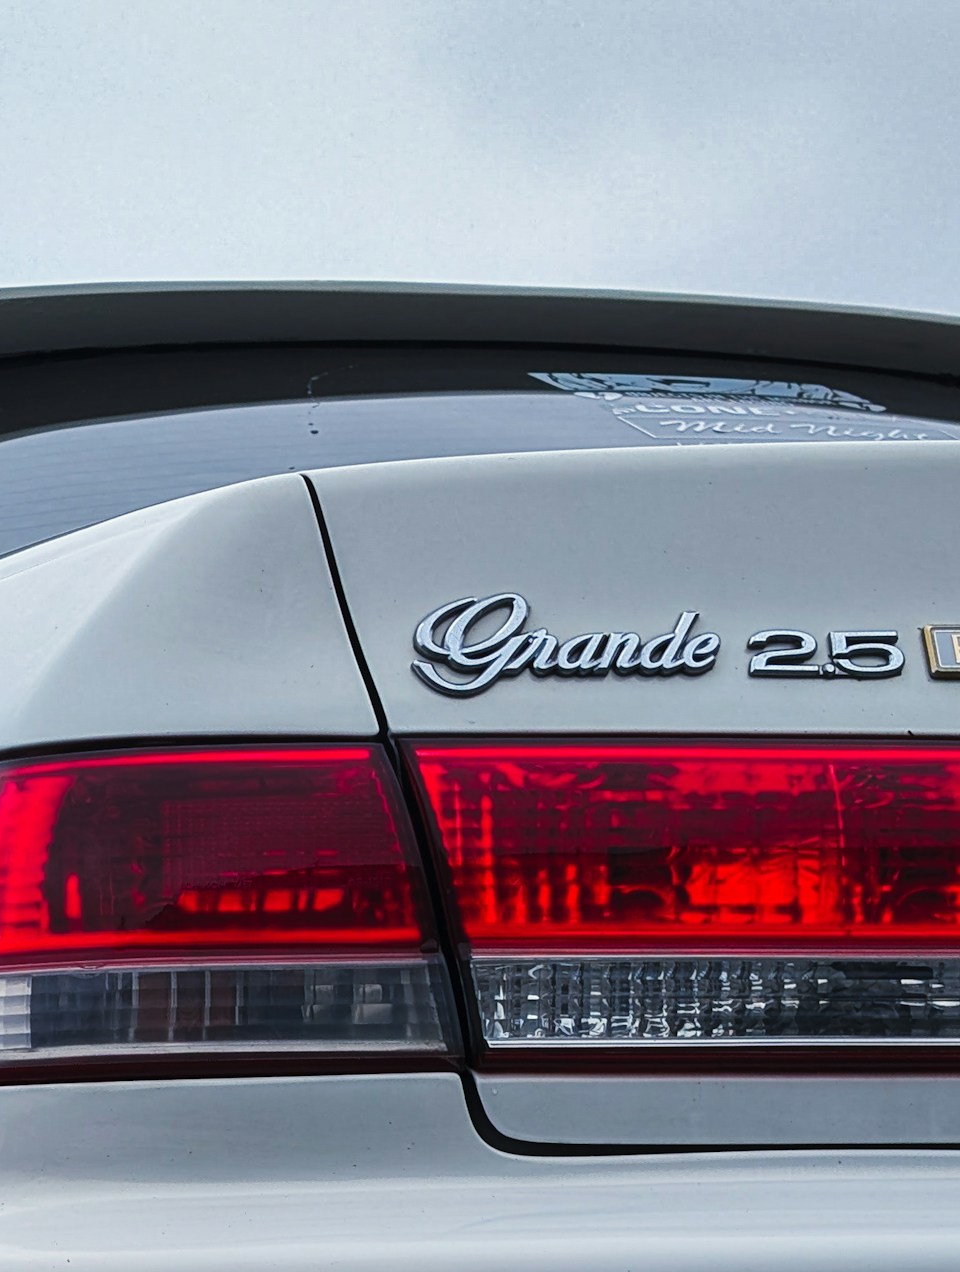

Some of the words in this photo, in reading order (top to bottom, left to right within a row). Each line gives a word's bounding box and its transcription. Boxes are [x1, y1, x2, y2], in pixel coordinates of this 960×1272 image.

[660, 419, 783, 434] Mid
[411, 592, 721, 698] Grande
[747, 629, 906, 679] 2.5
